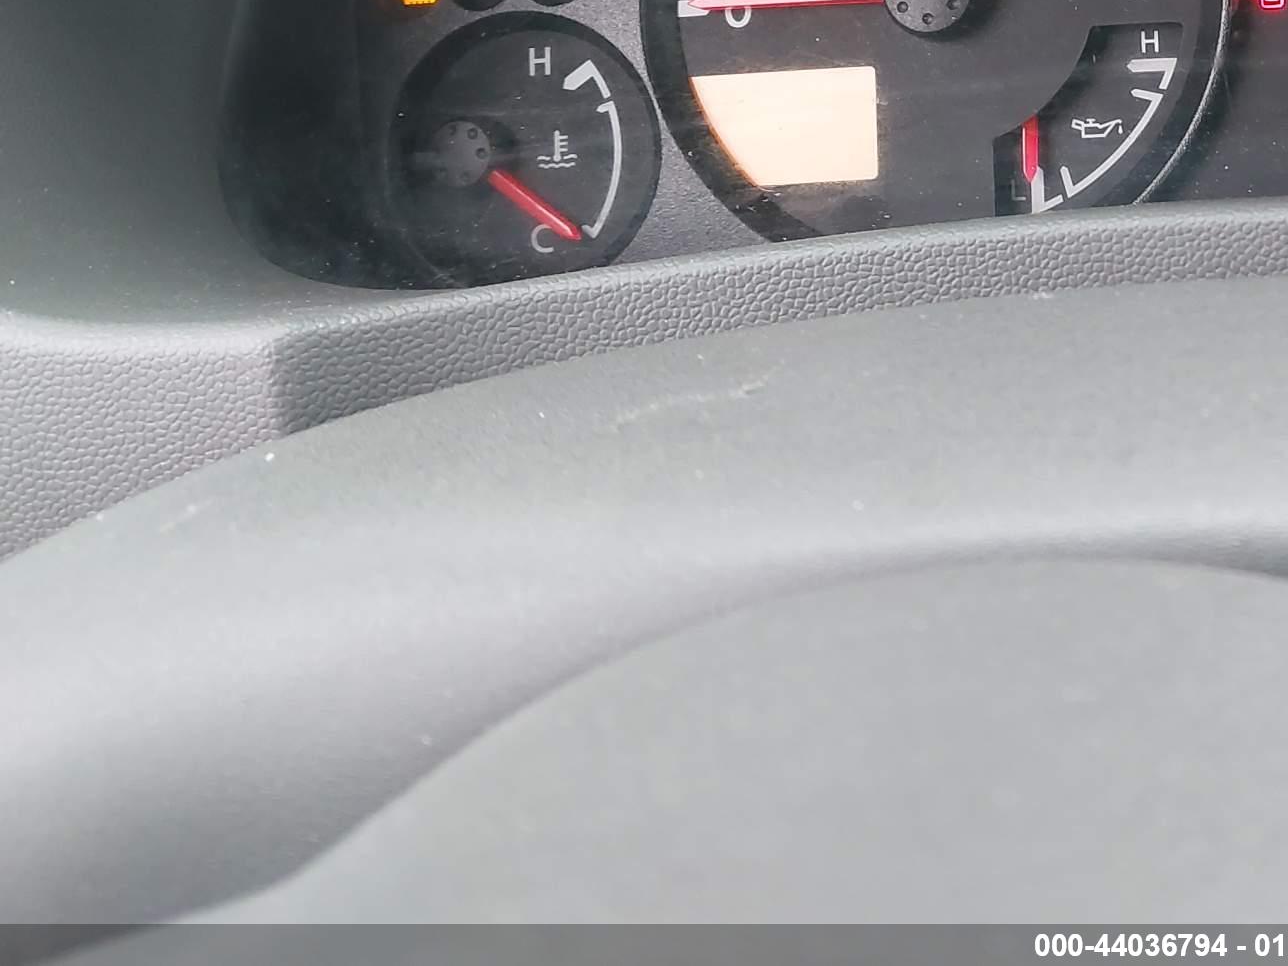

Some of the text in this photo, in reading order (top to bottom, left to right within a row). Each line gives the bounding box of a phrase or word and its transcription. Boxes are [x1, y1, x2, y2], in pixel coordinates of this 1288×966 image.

[1140, 30, 1160, 54] H
[529, 46, 551, 77] H
[531, 224, 555, 253] C
